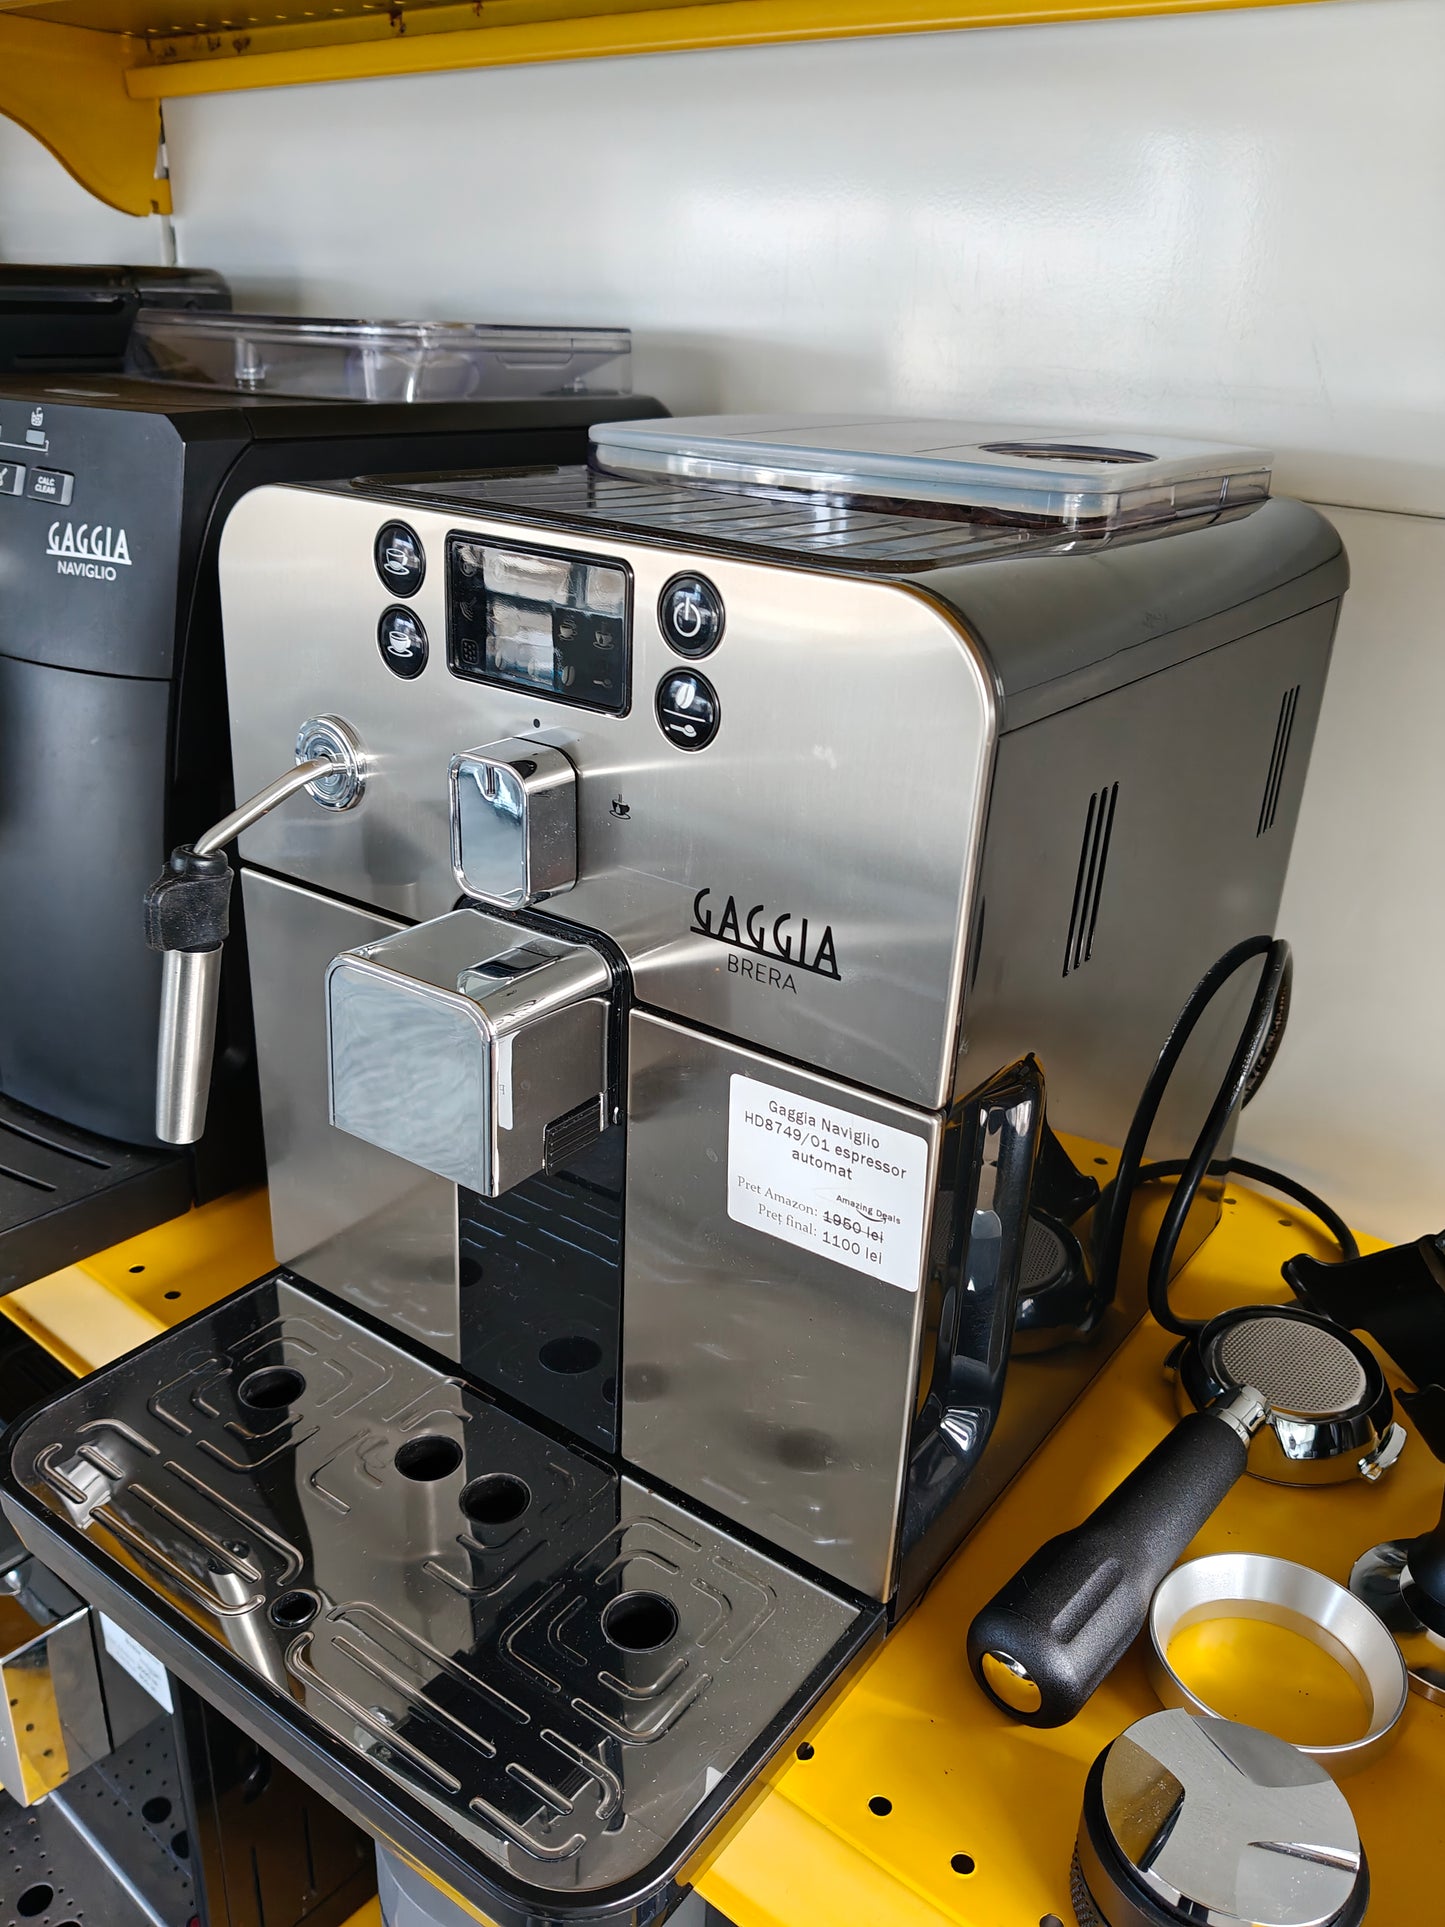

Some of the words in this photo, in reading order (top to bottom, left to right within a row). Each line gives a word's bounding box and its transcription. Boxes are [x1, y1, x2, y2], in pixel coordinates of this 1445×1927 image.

[35, 484, 56, 495] CLEAN
[38, 476, 55, 486] CALC
[46, 521, 132, 565] GAGGIA
[57, 560, 117, 581] NAVIGLIO
[690, 887, 842, 981] GAGGIA
[727, 953, 798, 995] BRERA
[744, 1110, 830, 1152] HD8749/01
[834, 1144, 907, 1179] espressor
[768, 1100, 816, 1127] Gaggia
[821, 1117, 880, 1149] Naviglio
[791, 1148, 853, 1180] automat
[764, 1187, 818, 1217] Amazon:
[866, 1225, 884, 1243] lei
[835, 1195, 873, 1216] Amazing
[876, 1208, 901, 1225] Deals
[785, 1215, 817, 1237] final:
[821, 1231, 861, 1255] 1100
[865, 1246, 883, 1265] lei
